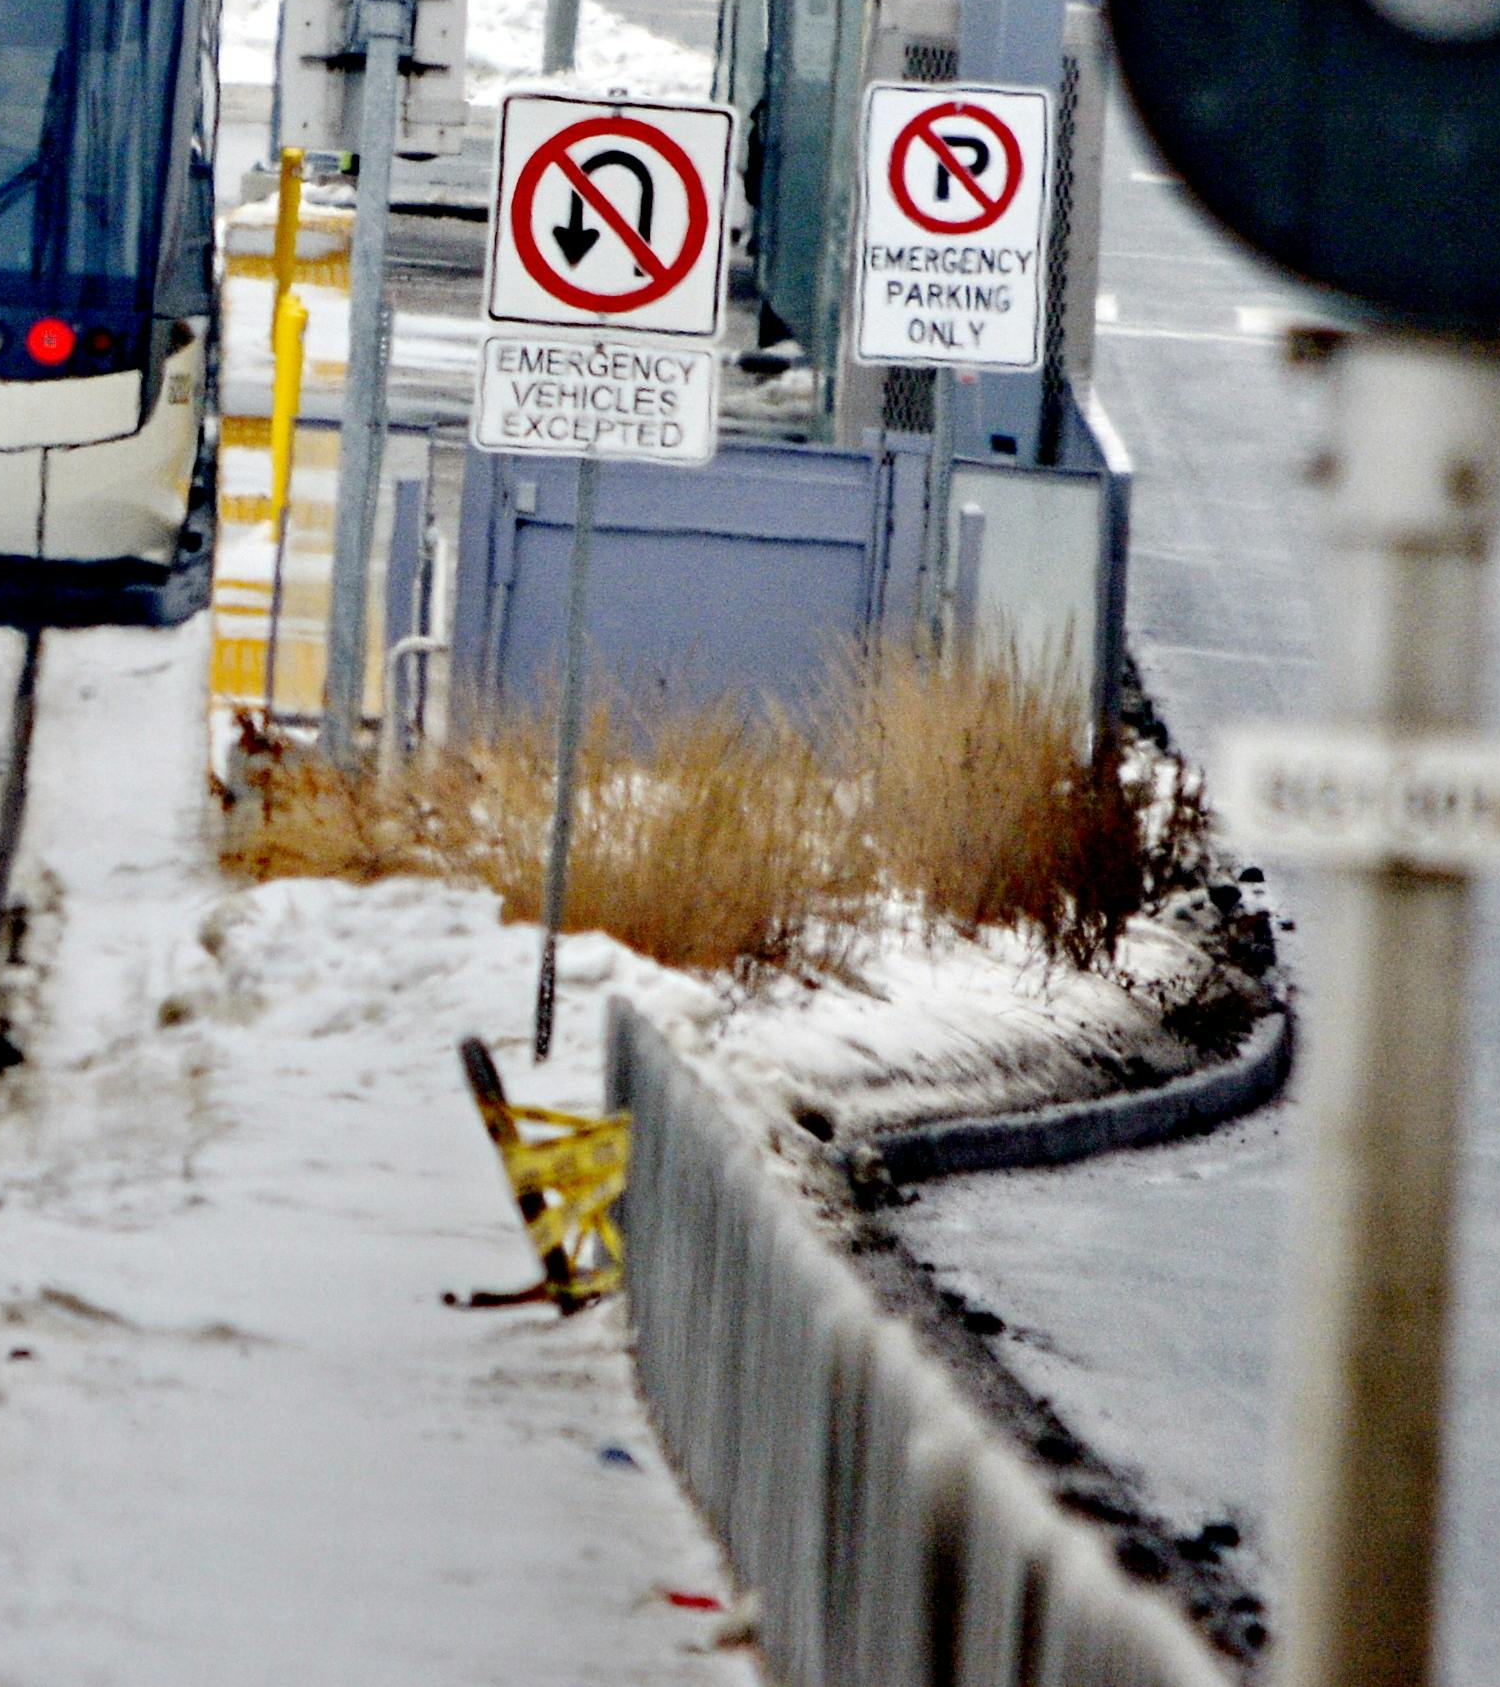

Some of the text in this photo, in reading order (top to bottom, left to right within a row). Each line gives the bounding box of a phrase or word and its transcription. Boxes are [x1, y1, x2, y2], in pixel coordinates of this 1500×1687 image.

[871, 246, 1033, 275] EMERGENCY
[886, 280, 1011, 313] PARKING
[907, 318, 986, 349] ONLY
[499, 345, 695, 385] EMERGENCY
[511, 380, 679, 416] VEHICLES
[502, 412, 684, 448] EXCEPTED
